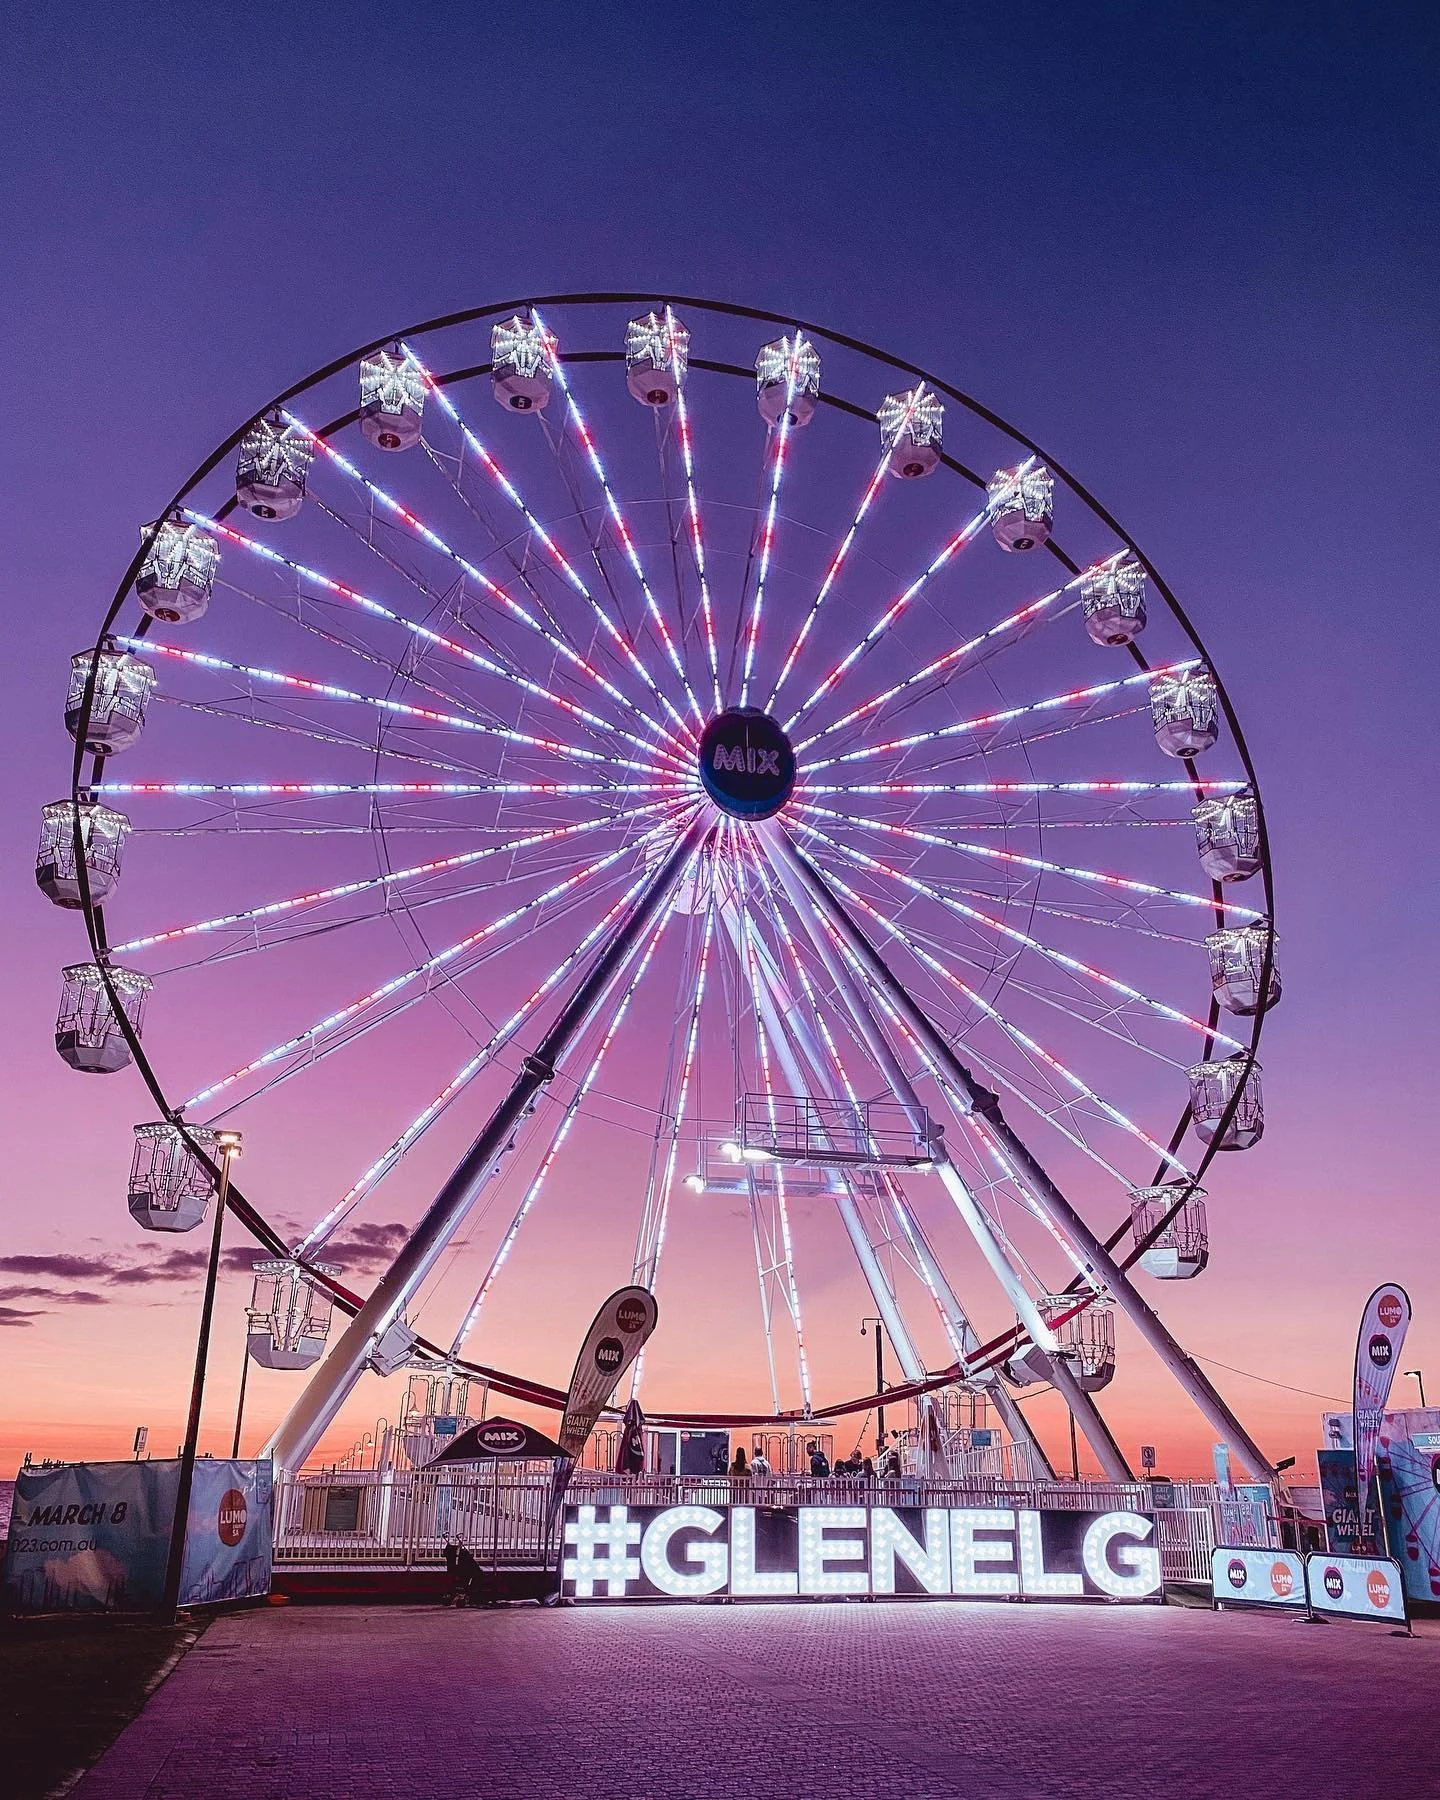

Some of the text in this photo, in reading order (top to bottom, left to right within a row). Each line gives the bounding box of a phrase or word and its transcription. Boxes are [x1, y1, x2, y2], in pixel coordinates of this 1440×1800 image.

[713, 743, 780, 776] MIX
[619, 1309, 646, 1321] LUMO
[1380, 1306, 1402, 1316] LUMO
[598, 1348, 619, 1362] MIX
[1371, 1345, 1390, 1357] MIX
[566, 1414, 591, 1427] GIANT
[1357, 1409, 1379, 1420] GIANT
[1360, 1420, 1380, 1428] WHEEL
[483, 1431, 519, 1441] MIX
[567, 1426, 588, 1436] WHEEL
[28, 1502, 106, 1526] MARCH
[110, 1501, 128, 1525] 8
[220, 1509, 247, 1524] LUMO
[564, 1505, 1161, 1597] #GLENELG
[1229, 1568, 1245, 1580] MIX
[1271, 1574, 1292, 1584] LUMO
[1326, 1577, 1341, 1590] MIX
[1368, 1584, 1389, 1594] LUMO
